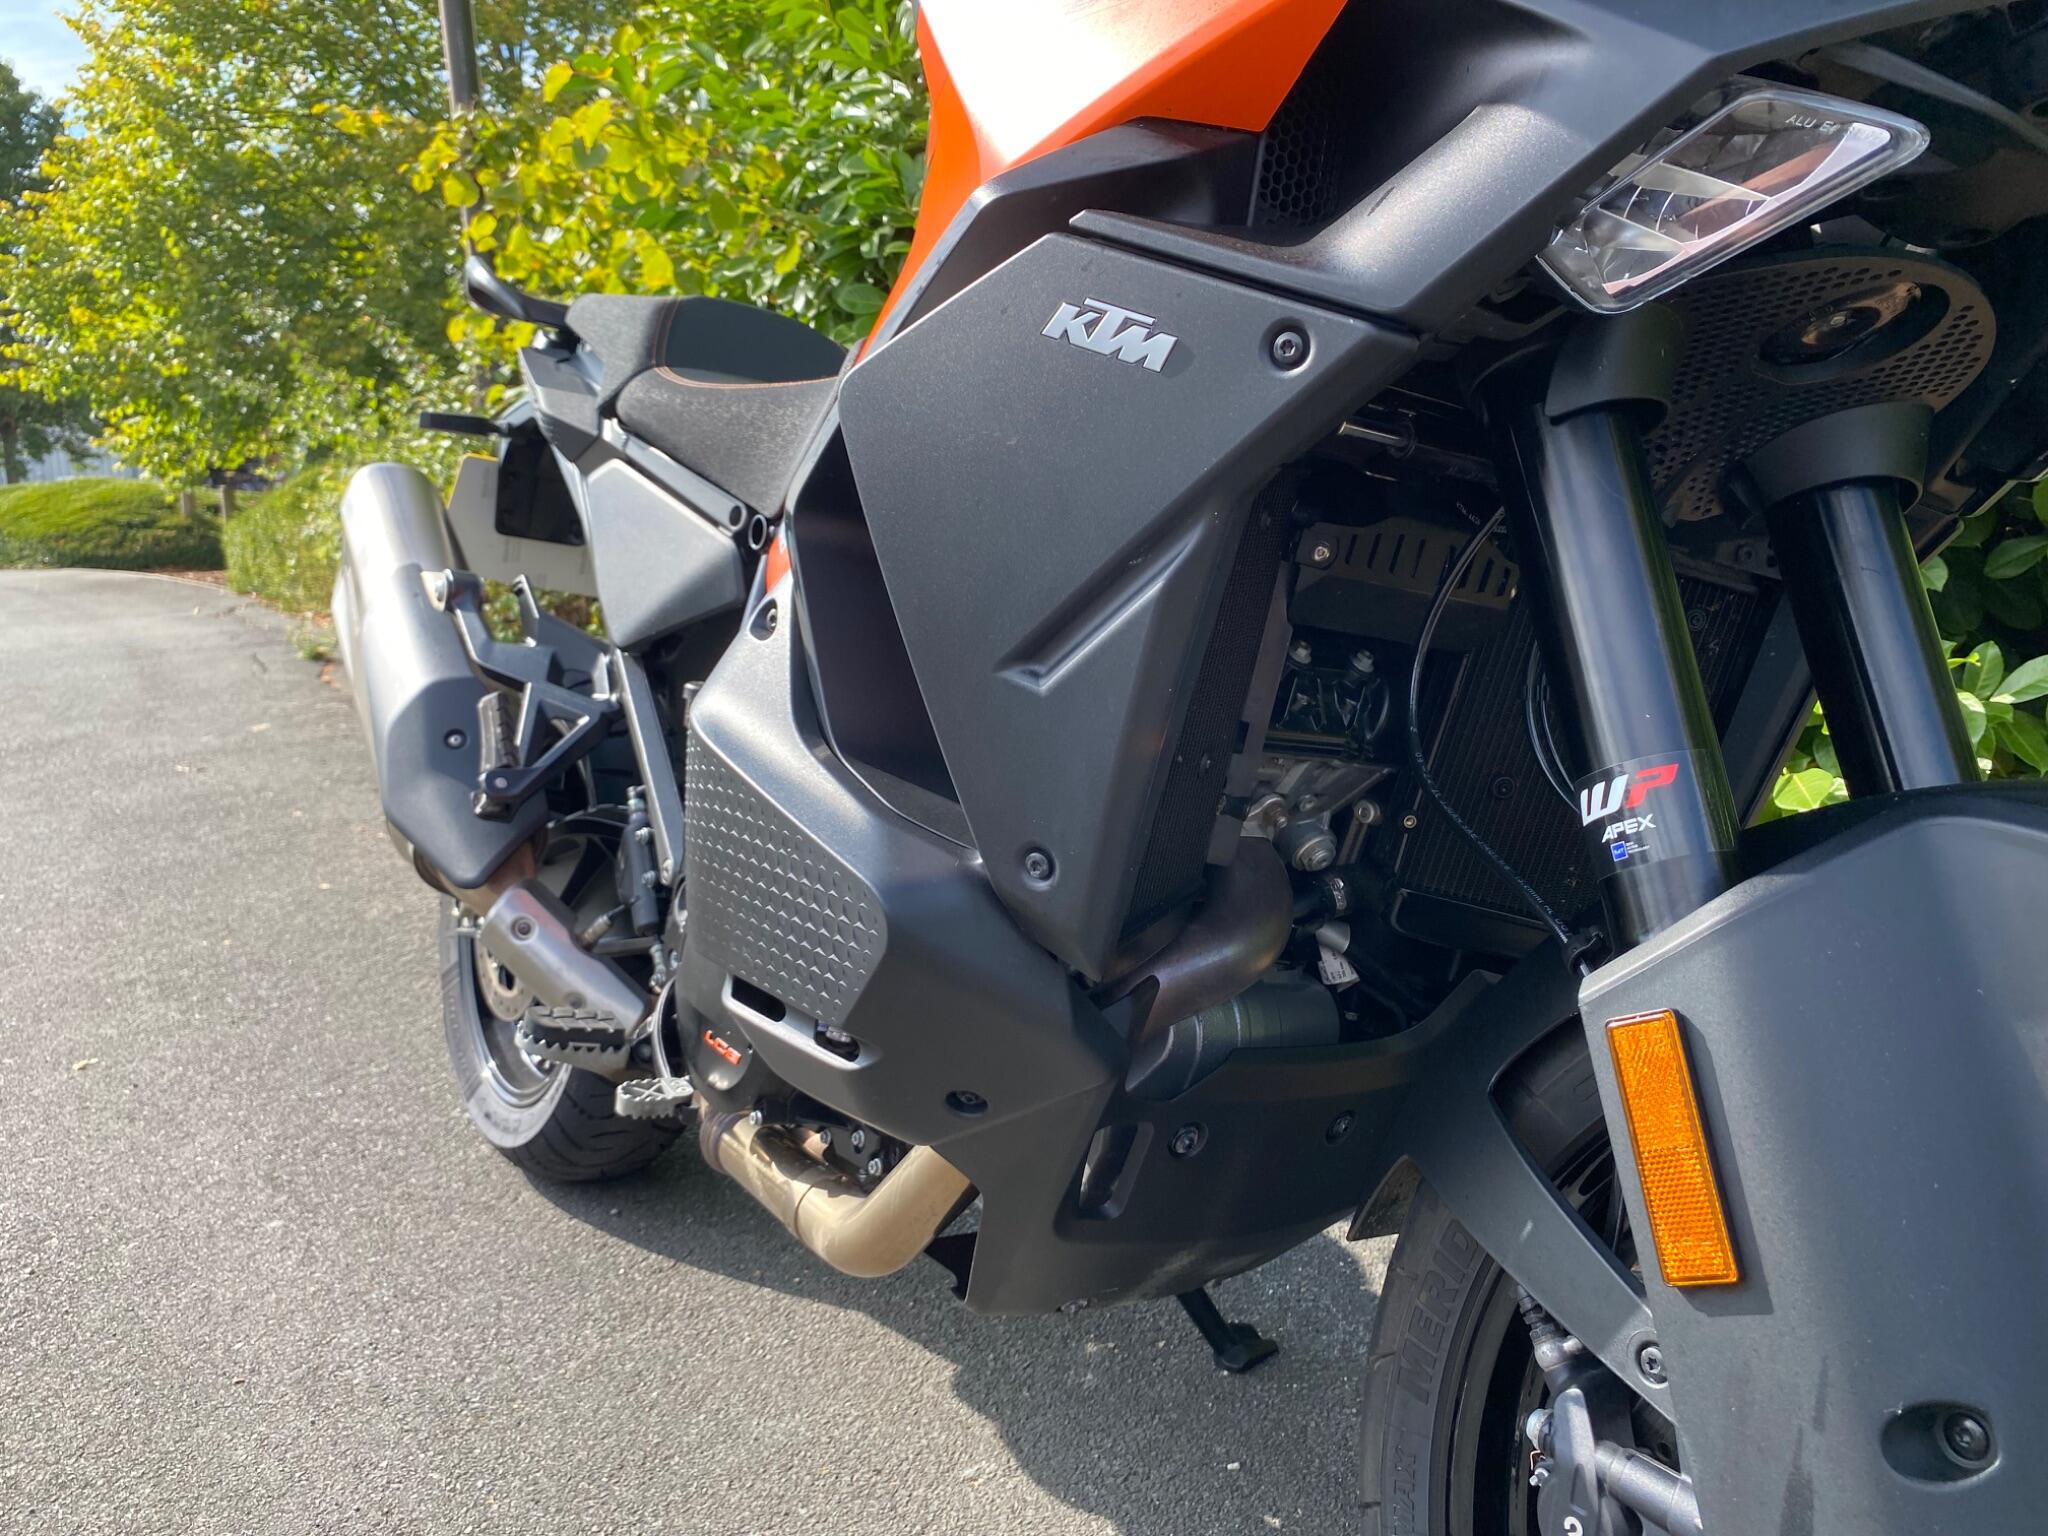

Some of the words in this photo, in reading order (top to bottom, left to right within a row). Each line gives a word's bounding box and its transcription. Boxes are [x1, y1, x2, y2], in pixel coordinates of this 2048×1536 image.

[1785, 113, 1817, 128] ALU
[1041, 297, 1178, 373] KTM
[1580, 763, 1680, 827] WP
[1601, 813, 1656, 844] APEX
